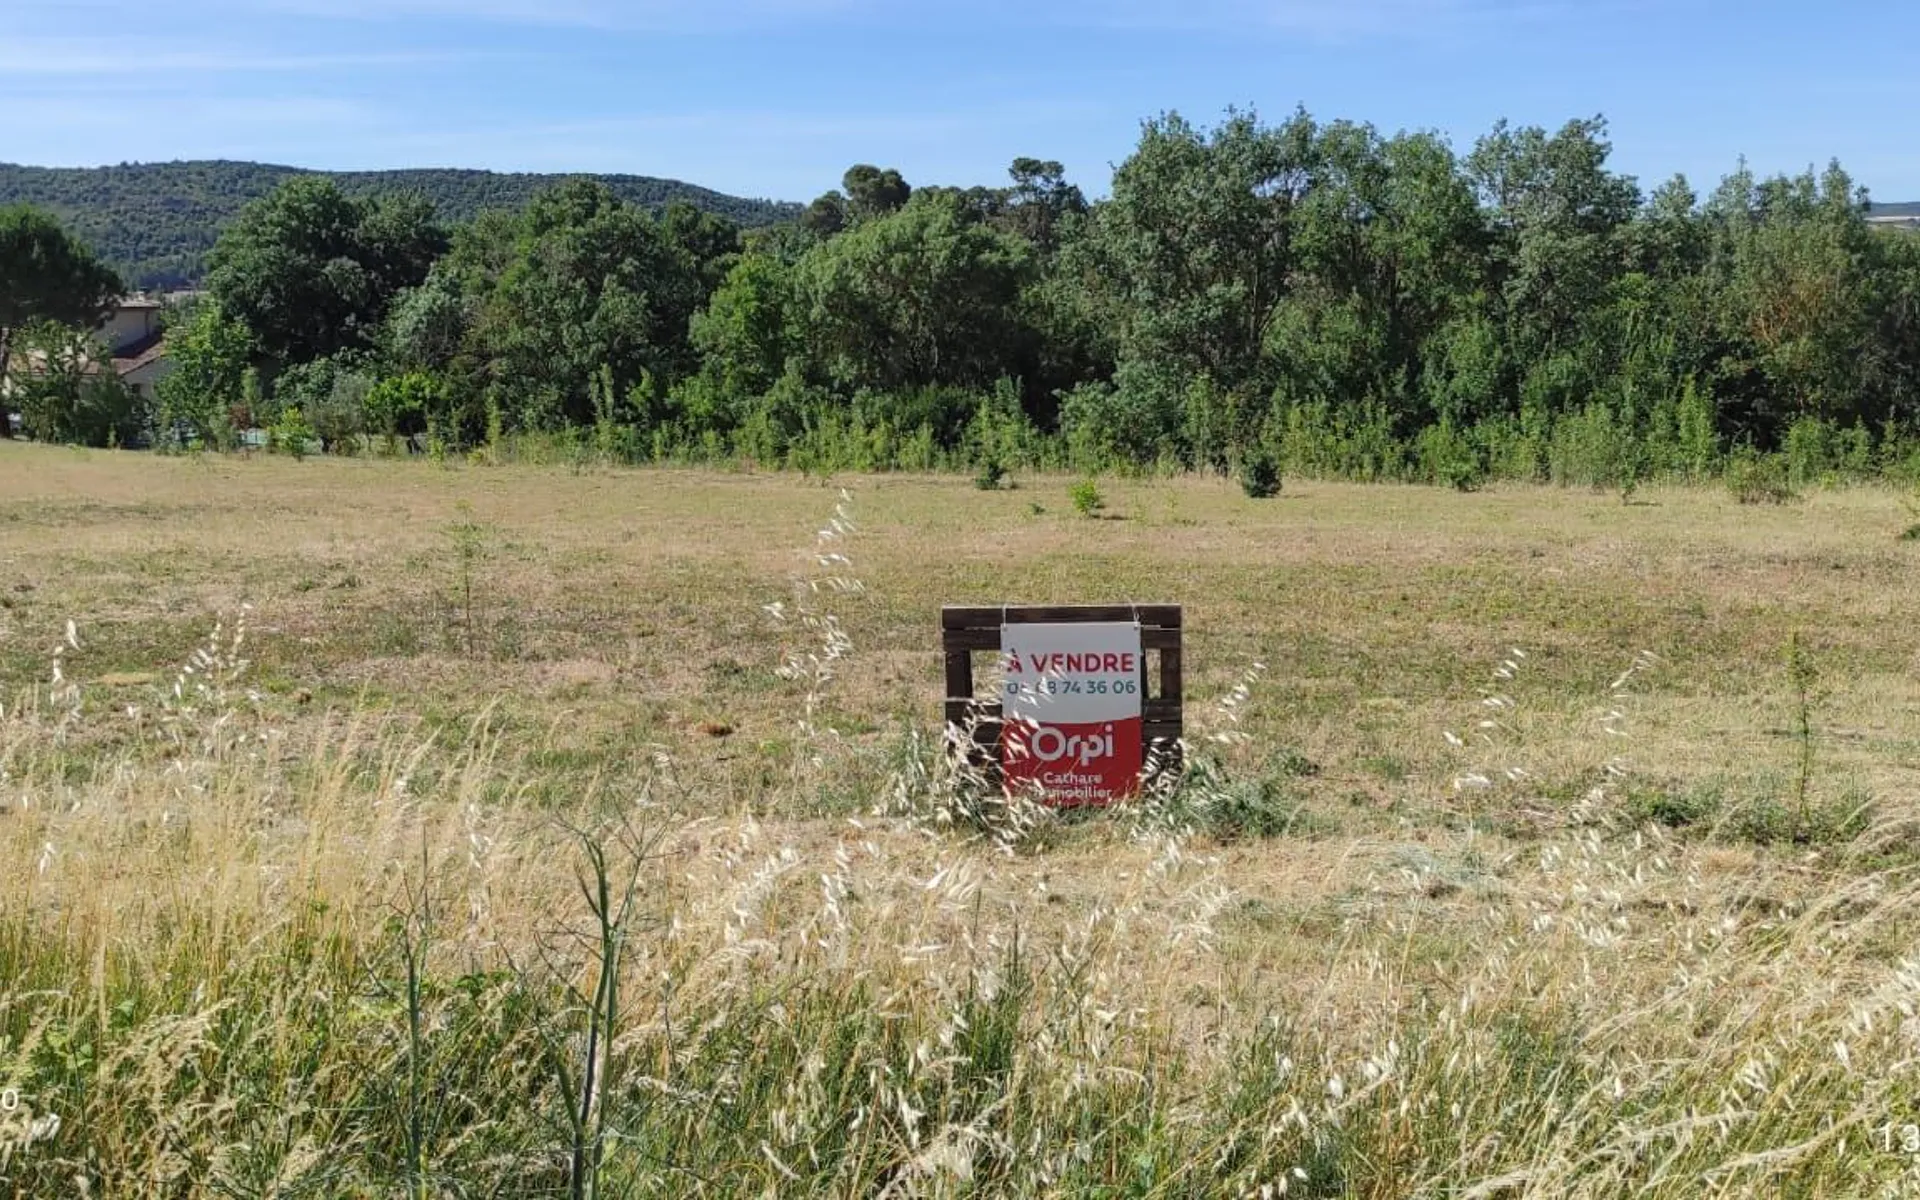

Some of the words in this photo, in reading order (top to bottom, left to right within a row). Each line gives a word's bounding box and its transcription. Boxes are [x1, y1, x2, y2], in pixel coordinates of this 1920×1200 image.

[1007, 648, 1023, 673] À
[1031, 653, 1135, 673] VENDRE
[1007, 681, 1031, 695] 0
[1062, 681, 1081, 694] 74
[1086, 681, 1107, 694] 36
[1112, 681, 1136, 694] 06
[1031, 724, 1113, 767] Orpi
[1043, 771, 1103, 784] Cathare
[1033, 786, 1112, 799] mobilier
